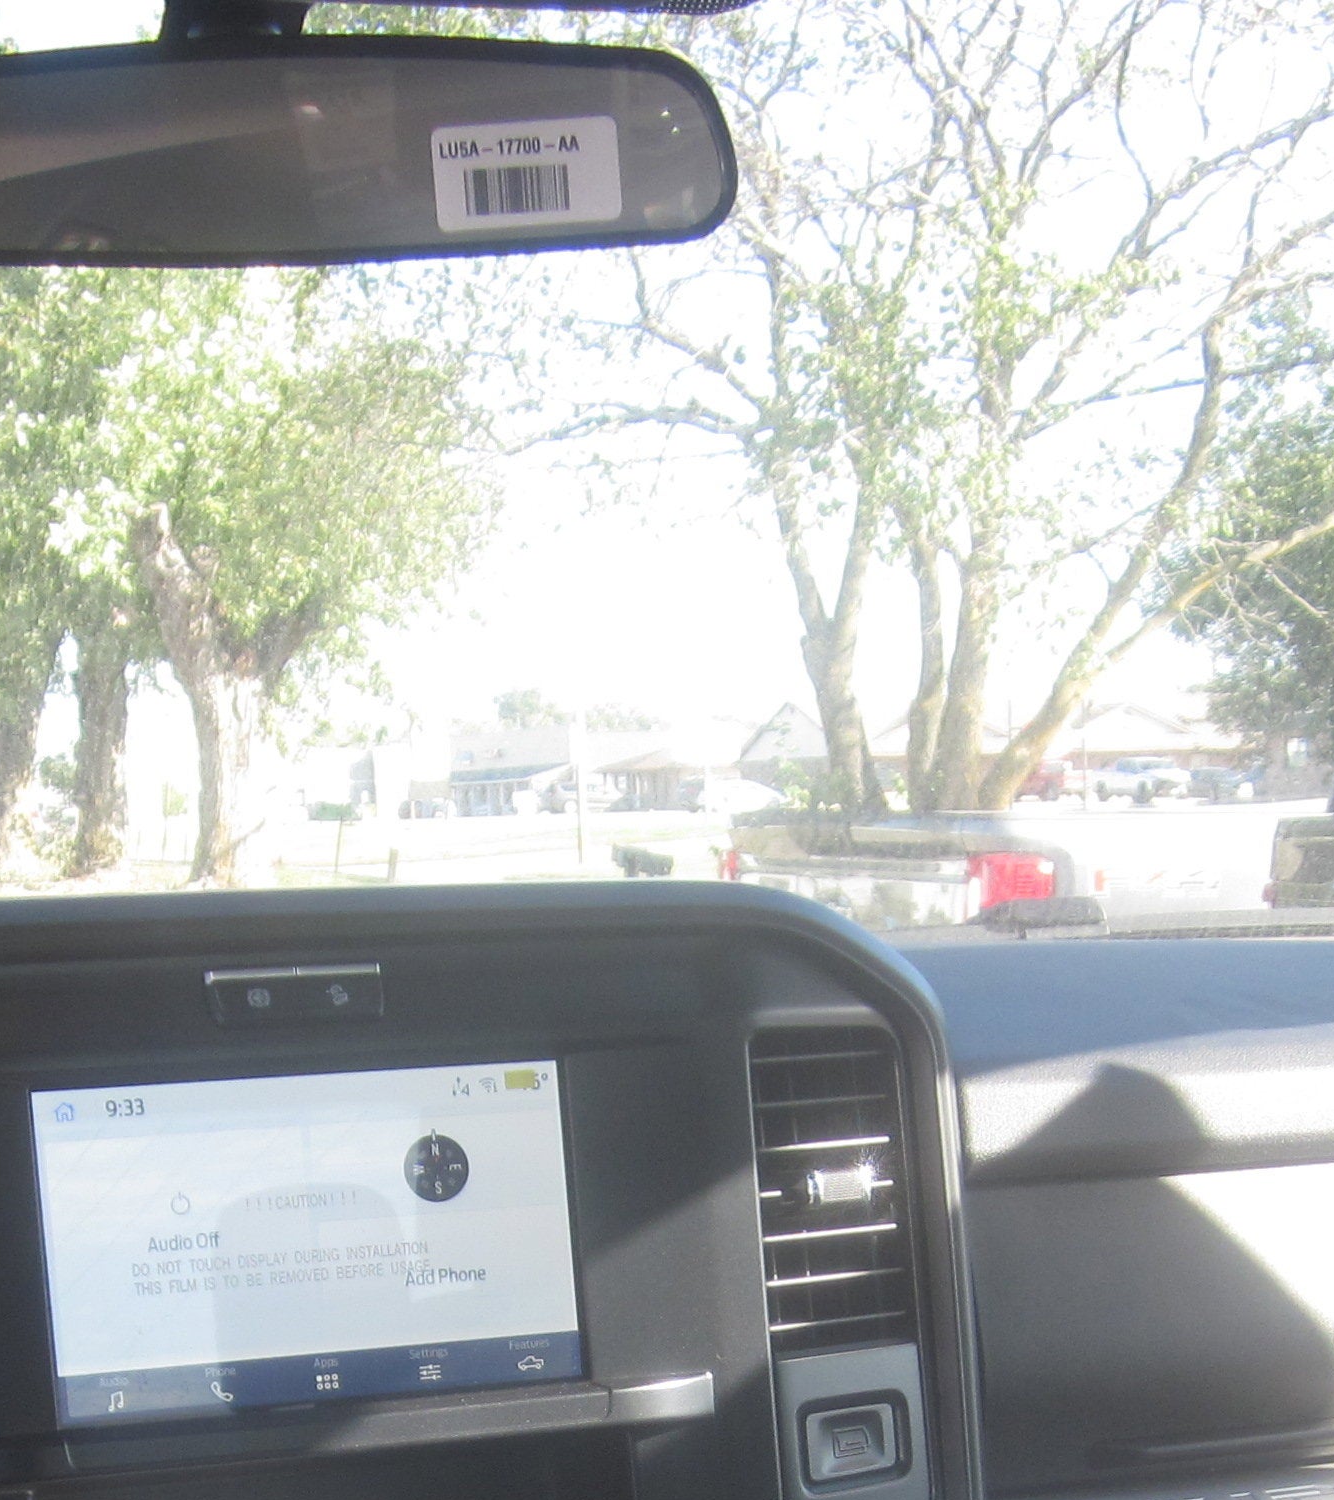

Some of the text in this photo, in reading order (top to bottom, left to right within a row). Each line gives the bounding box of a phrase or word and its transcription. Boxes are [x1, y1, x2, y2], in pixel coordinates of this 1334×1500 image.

[104, 1098, 146, 1118] 9:33
[431, 1142, 440, 1156] N
[434, 1180, 443, 1194] S
[147, 1231, 220, 1252] Audio Off
[131, 1241, 429, 1277] DO NOT TOUCH DISPLAY DURING INSTALLATION
[135, 1281, 162, 1297] THIS
[168, 1277, 197, 1293] FILM
[203, 1276, 216, 1291] IS
[222, 1274, 240, 1289] TO
[247, 1271, 263, 1287] BE
[269, 1267, 330, 1285] REMOVED
[336, 1263, 385, 1280] BEFORE
[405, 1265, 487, 1287] Add Phone
[507, 1337, 550, 1351] Features
[409, 1346, 448, 1360] Settings
[314, 1356, 339, 1369] Apps
[205, 1365, 236, 1378] Phone
